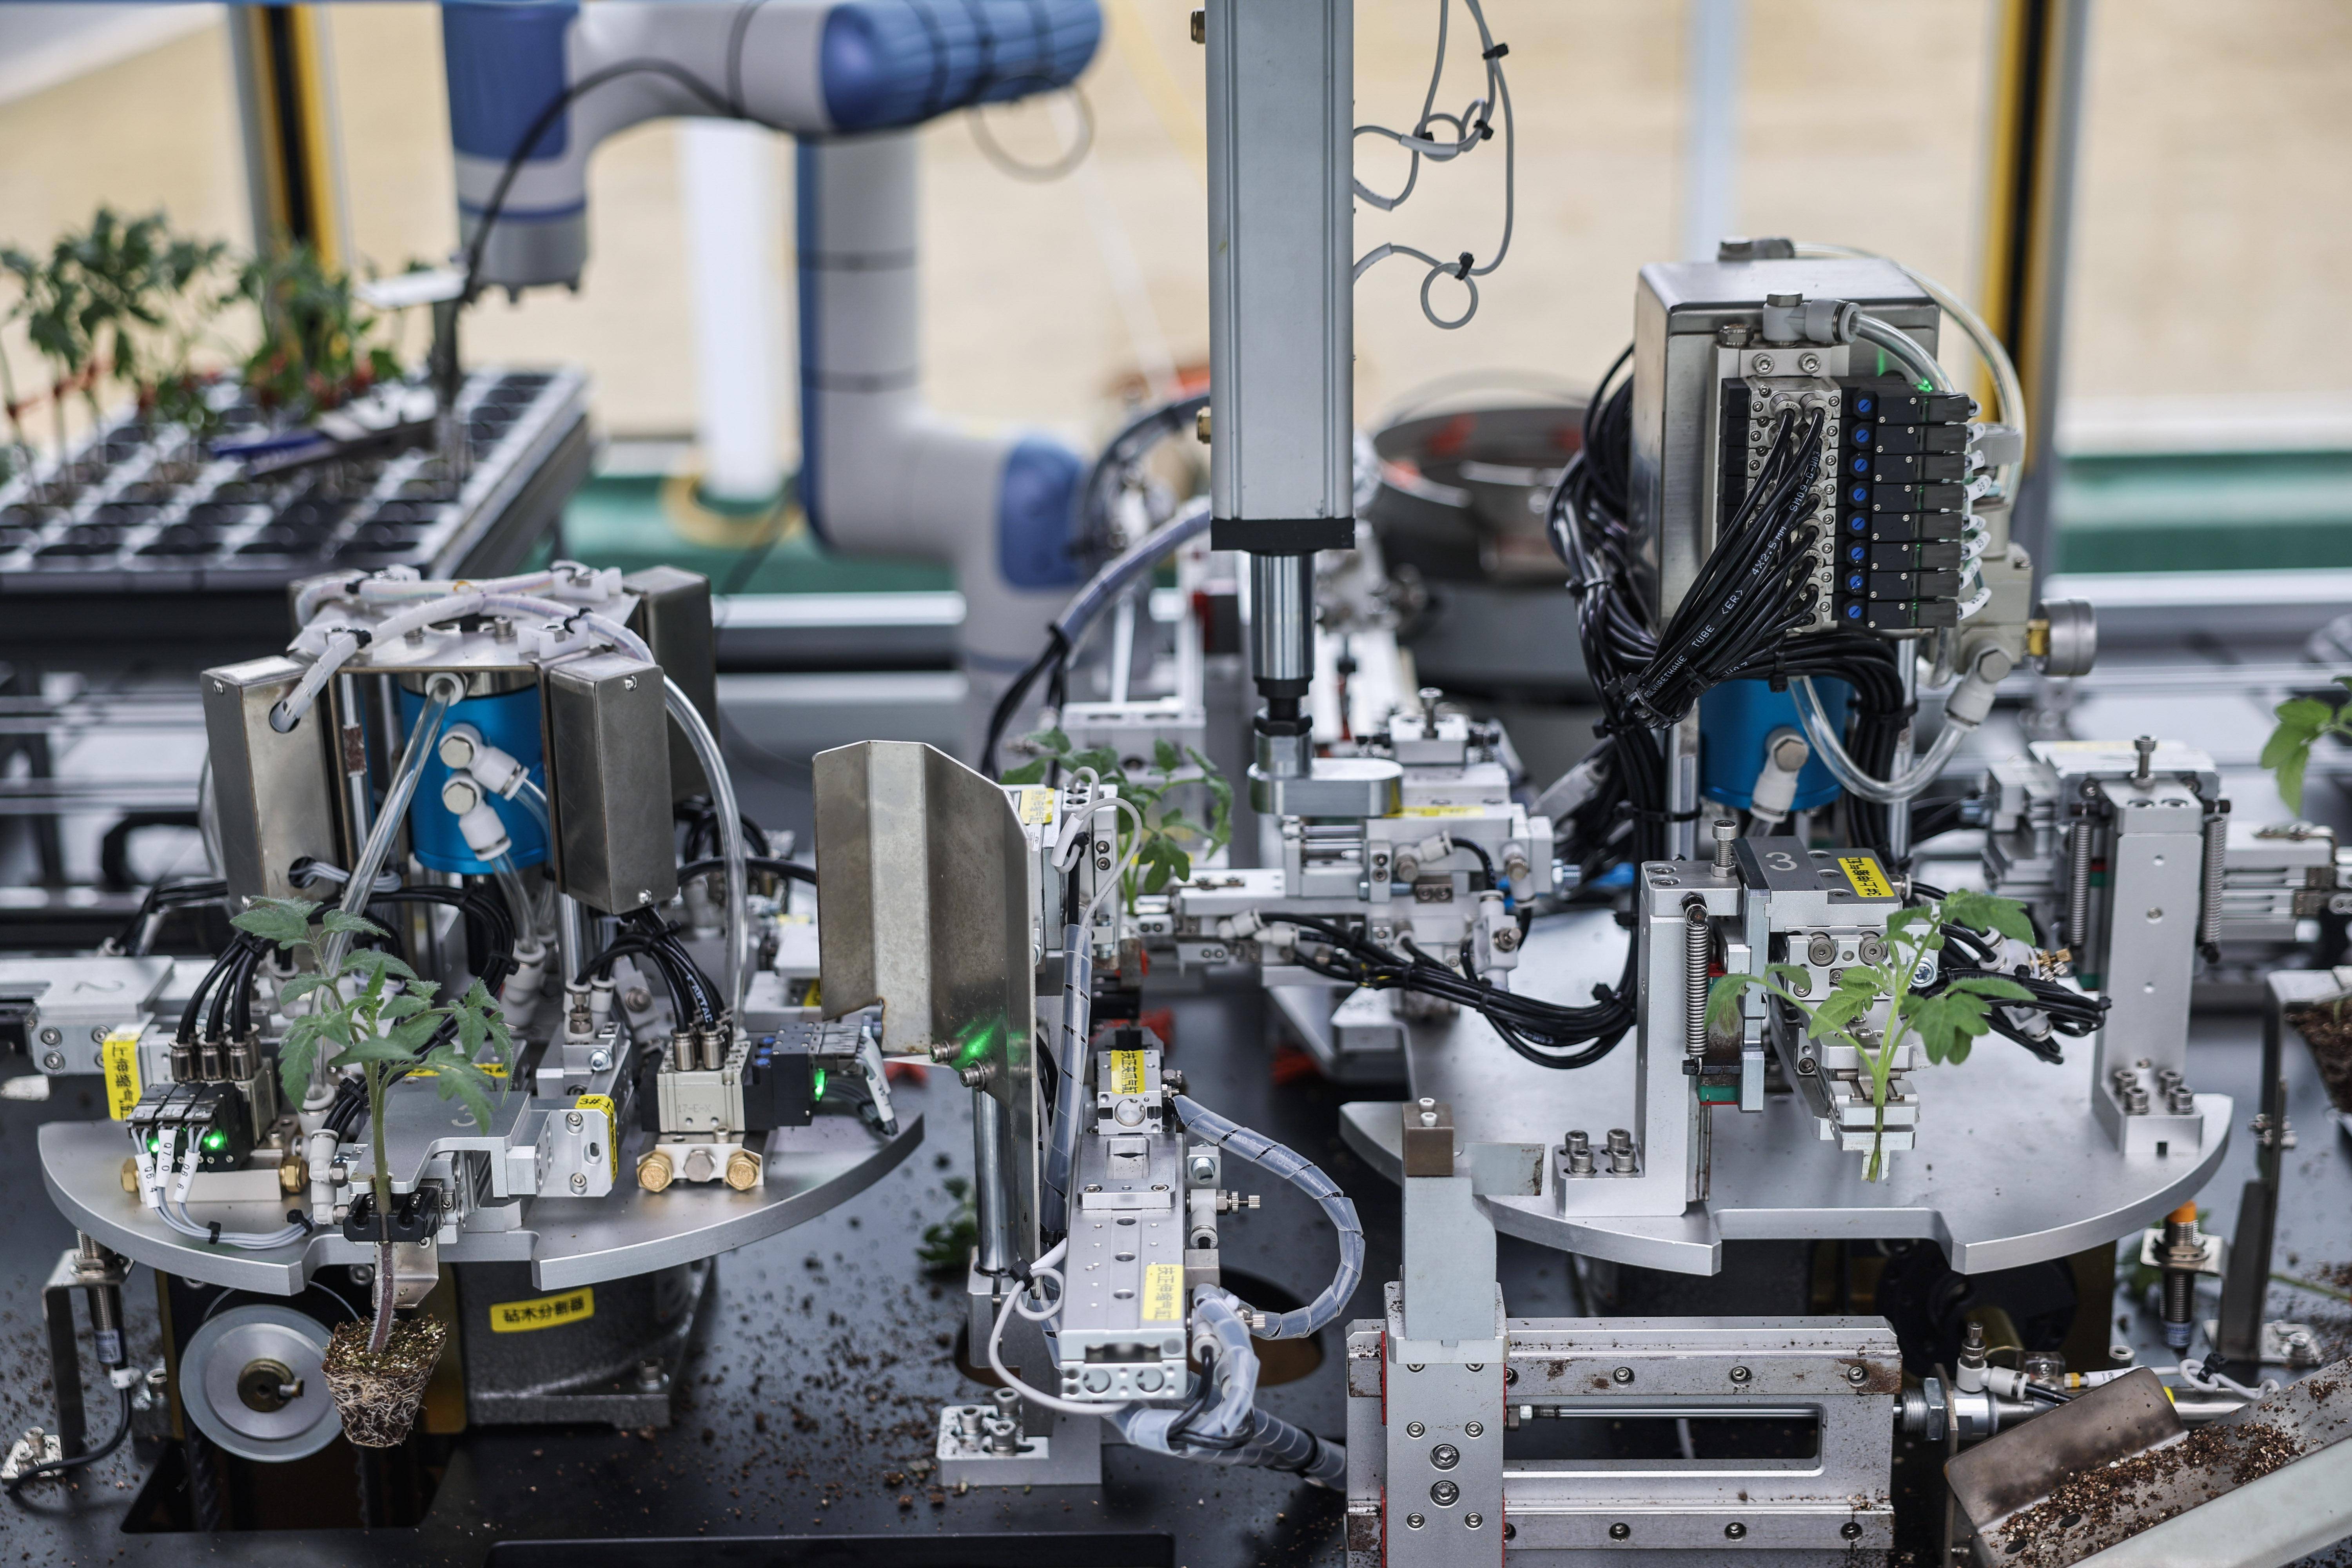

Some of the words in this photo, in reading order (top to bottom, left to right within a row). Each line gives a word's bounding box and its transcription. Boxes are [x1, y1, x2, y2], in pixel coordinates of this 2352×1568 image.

[1691, 624, 1715, 647] TUBE
[1766, 851, 1798, 871] 3
[1846, 857, 1882, 897] 3#上伸缩气缸
[1121, 1052, 1138, 1094] 扶正夹爪气缸
[162, 1142, 172, 1172] Q7.0
[144, 1166, 157, 1193] Q6.4
[1155, 1267, 1176, 1318] 扶正伸缩气缸
[503, 1295, 584, 1323] 砧木分割器
